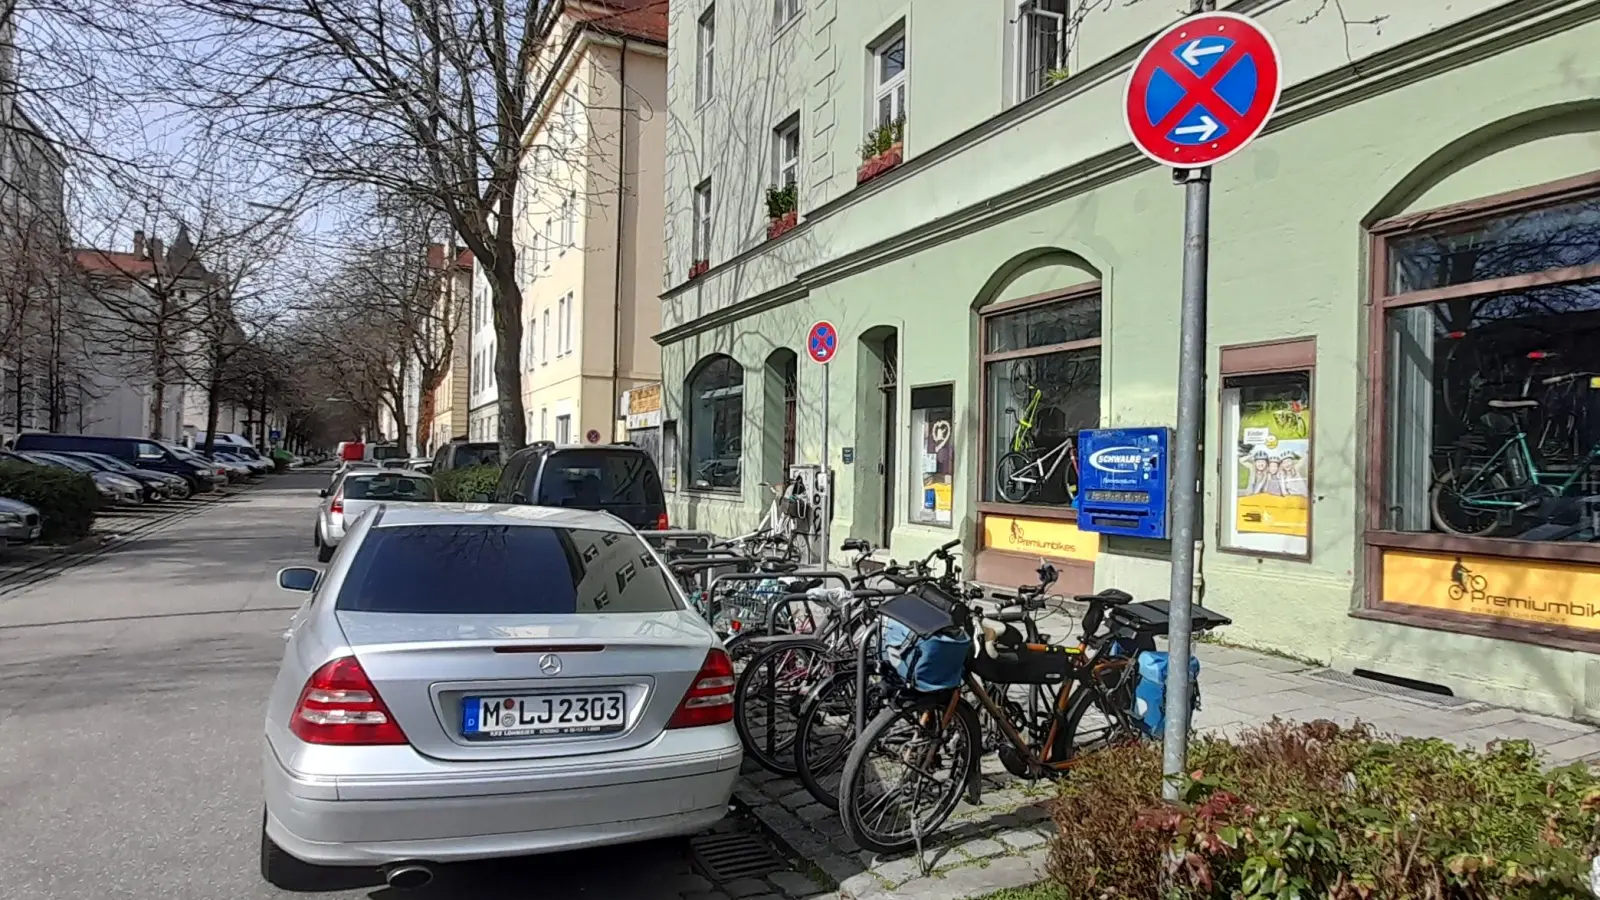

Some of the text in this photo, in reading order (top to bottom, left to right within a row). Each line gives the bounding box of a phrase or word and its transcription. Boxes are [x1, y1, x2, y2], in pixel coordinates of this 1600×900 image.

[1098, 454, 1142, 464] SCHWALBE
[1017, 536, 1077, 553] Premiumbikes
[483, 701, 499, 727] M
[467, 718, 475, 727] D
